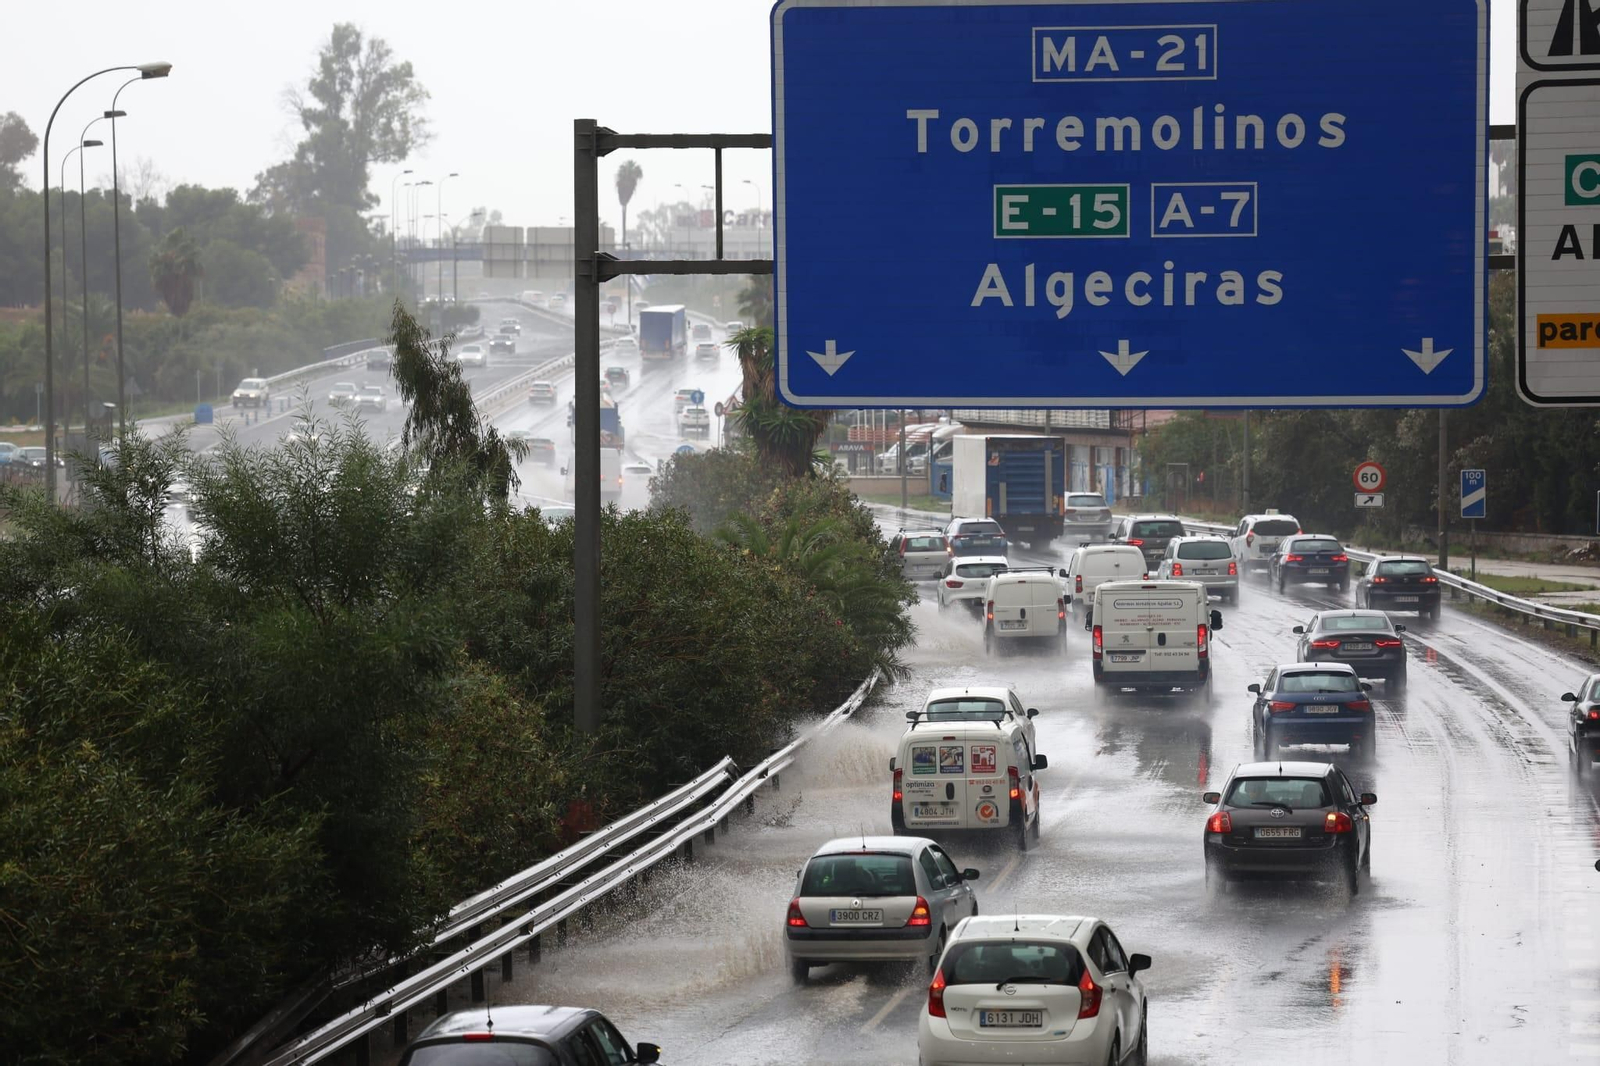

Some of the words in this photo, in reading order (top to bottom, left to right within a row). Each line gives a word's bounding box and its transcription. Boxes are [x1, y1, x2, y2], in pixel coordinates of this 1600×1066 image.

[1042, 34, 1207, 72] MA-21
[906, 103, 1347, 153] Torremolinos
[1001, 193, 1121, 230] E-15
[1159, 191, 1250, 229] A-7
[970, 260, 1284, 320] Algeciras
[1361, 472, 1379, 483] 60
[1465, 472, 1482, 480] 100
[1260, 828, 1281, 837] 0655
[1283, 828, 1300, 837] FRG
[836, 911, 860, 921] 3900
[862, 911, 880, 921] CRZ
[987, 1012, 1014, 1023] 6131
[1018, 1012, 1040, 1023] JDH
